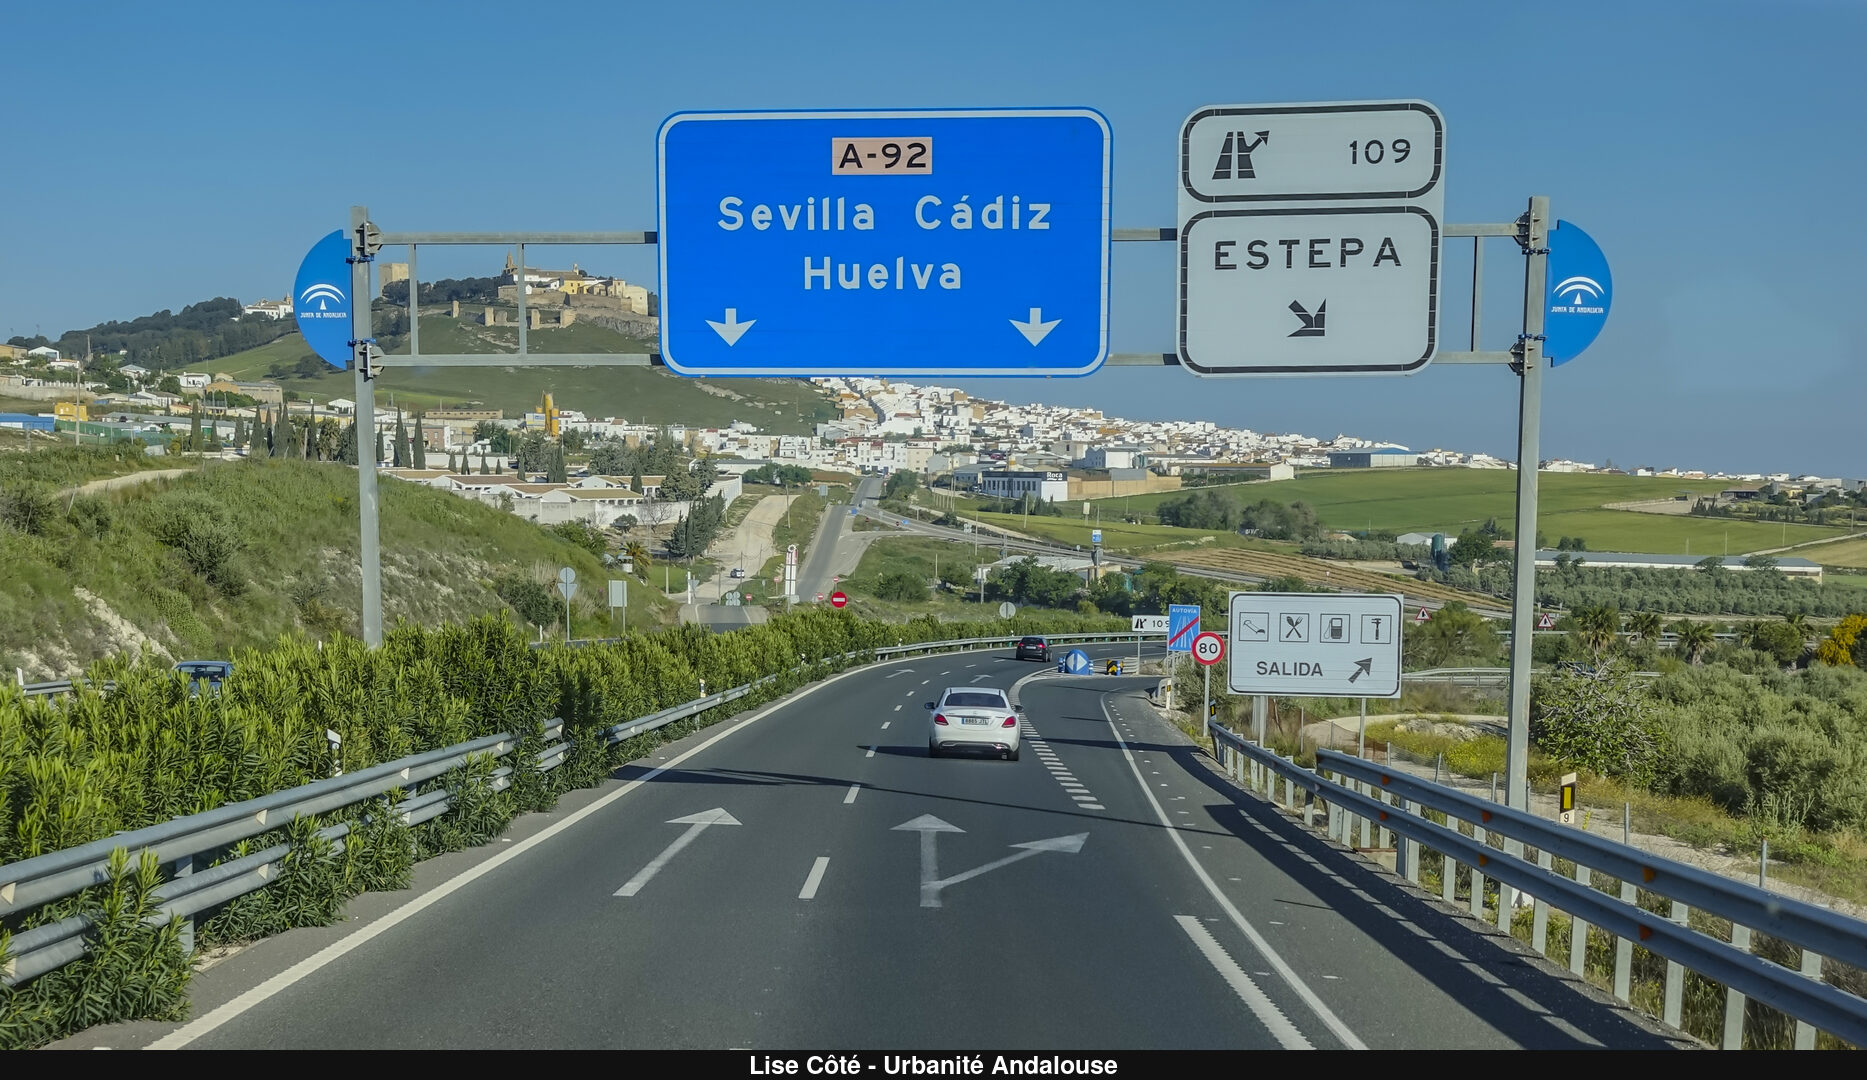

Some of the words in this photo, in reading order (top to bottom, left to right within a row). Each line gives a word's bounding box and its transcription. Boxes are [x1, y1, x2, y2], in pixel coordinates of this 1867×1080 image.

[838, 143, 927, 169] A-92
[1349, 138, 1411, 165] 109
[717, 196, 874, 231] Sevilla
[915, 195, 1051, 230] Cádiz
[1214, 237, 1402, 270] ESTEPA
[804, 256, 961, 290] Huelva
[1198, 642, 1218, 654] 80
[1256, 661, 1323, 677] SALIDA
[1564, 813, 1569, 823] 9
